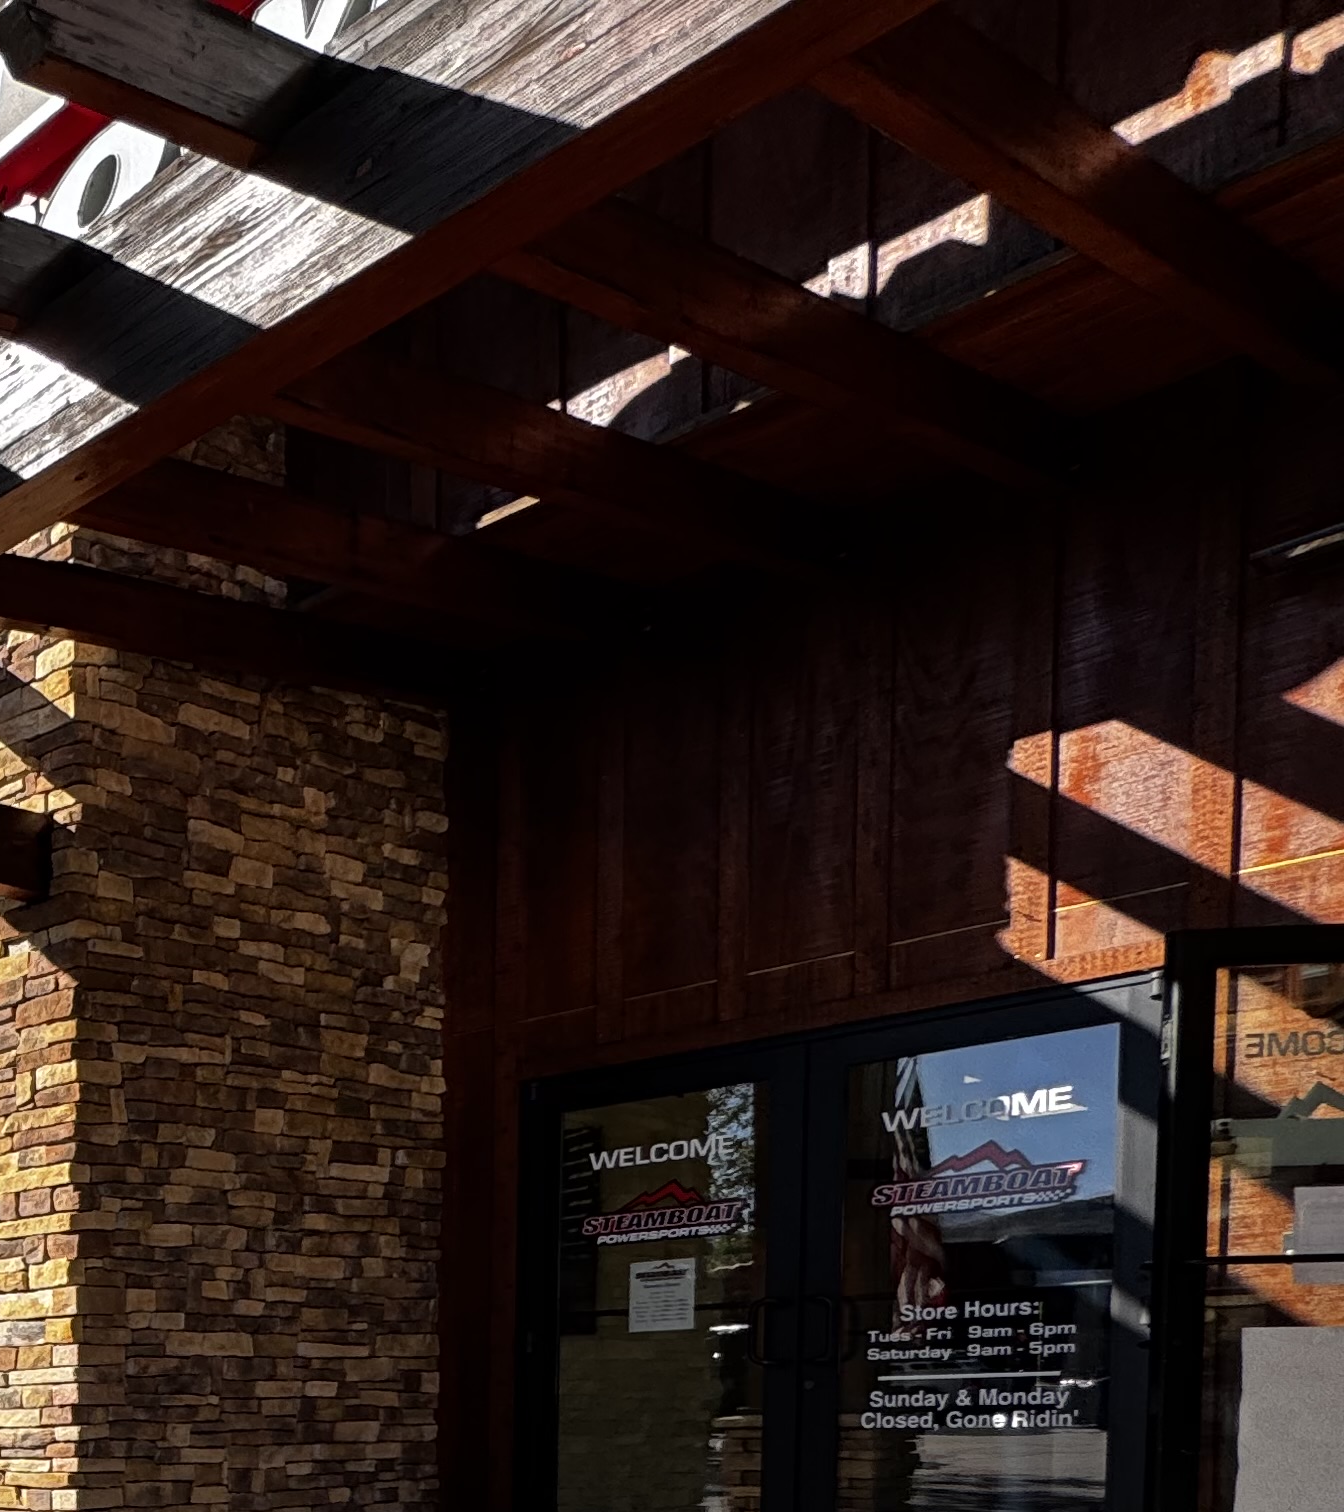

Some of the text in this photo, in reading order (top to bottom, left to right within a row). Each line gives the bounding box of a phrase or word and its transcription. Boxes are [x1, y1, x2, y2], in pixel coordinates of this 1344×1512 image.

[882, 1085, 1074, 1132] WELCOME
[589, 1135, 736, 1170] WELCOME
[872, 1162, 1085, 1206] STEAMBOAT
[890, 1193, 1038, 1217] POWERSPORTS
[582, 1202, 743, 1235] STEAMBOAT
[597, 1226, 711, 1245] POWERSPORTS
[900, 1301, 1039, 1321] Store Hours:
[868, 1330, 911, 1343] Tues
[926, 1327, 952, 1340] Fri
[968, 1326, 1012, 1339] 9am
[1029, 1323, 1077, 1338] 6pm
[867, 1347, 952, 1361] Saturday
[966, 1344, 1012, 1357] 9am
[1029, 1341, 1076, 1357] 5pm
[869, 1388, 1069, 1411] Sunday & Monday
[861, 1410, 1079, 1431] Closed, Gone Ridin'
